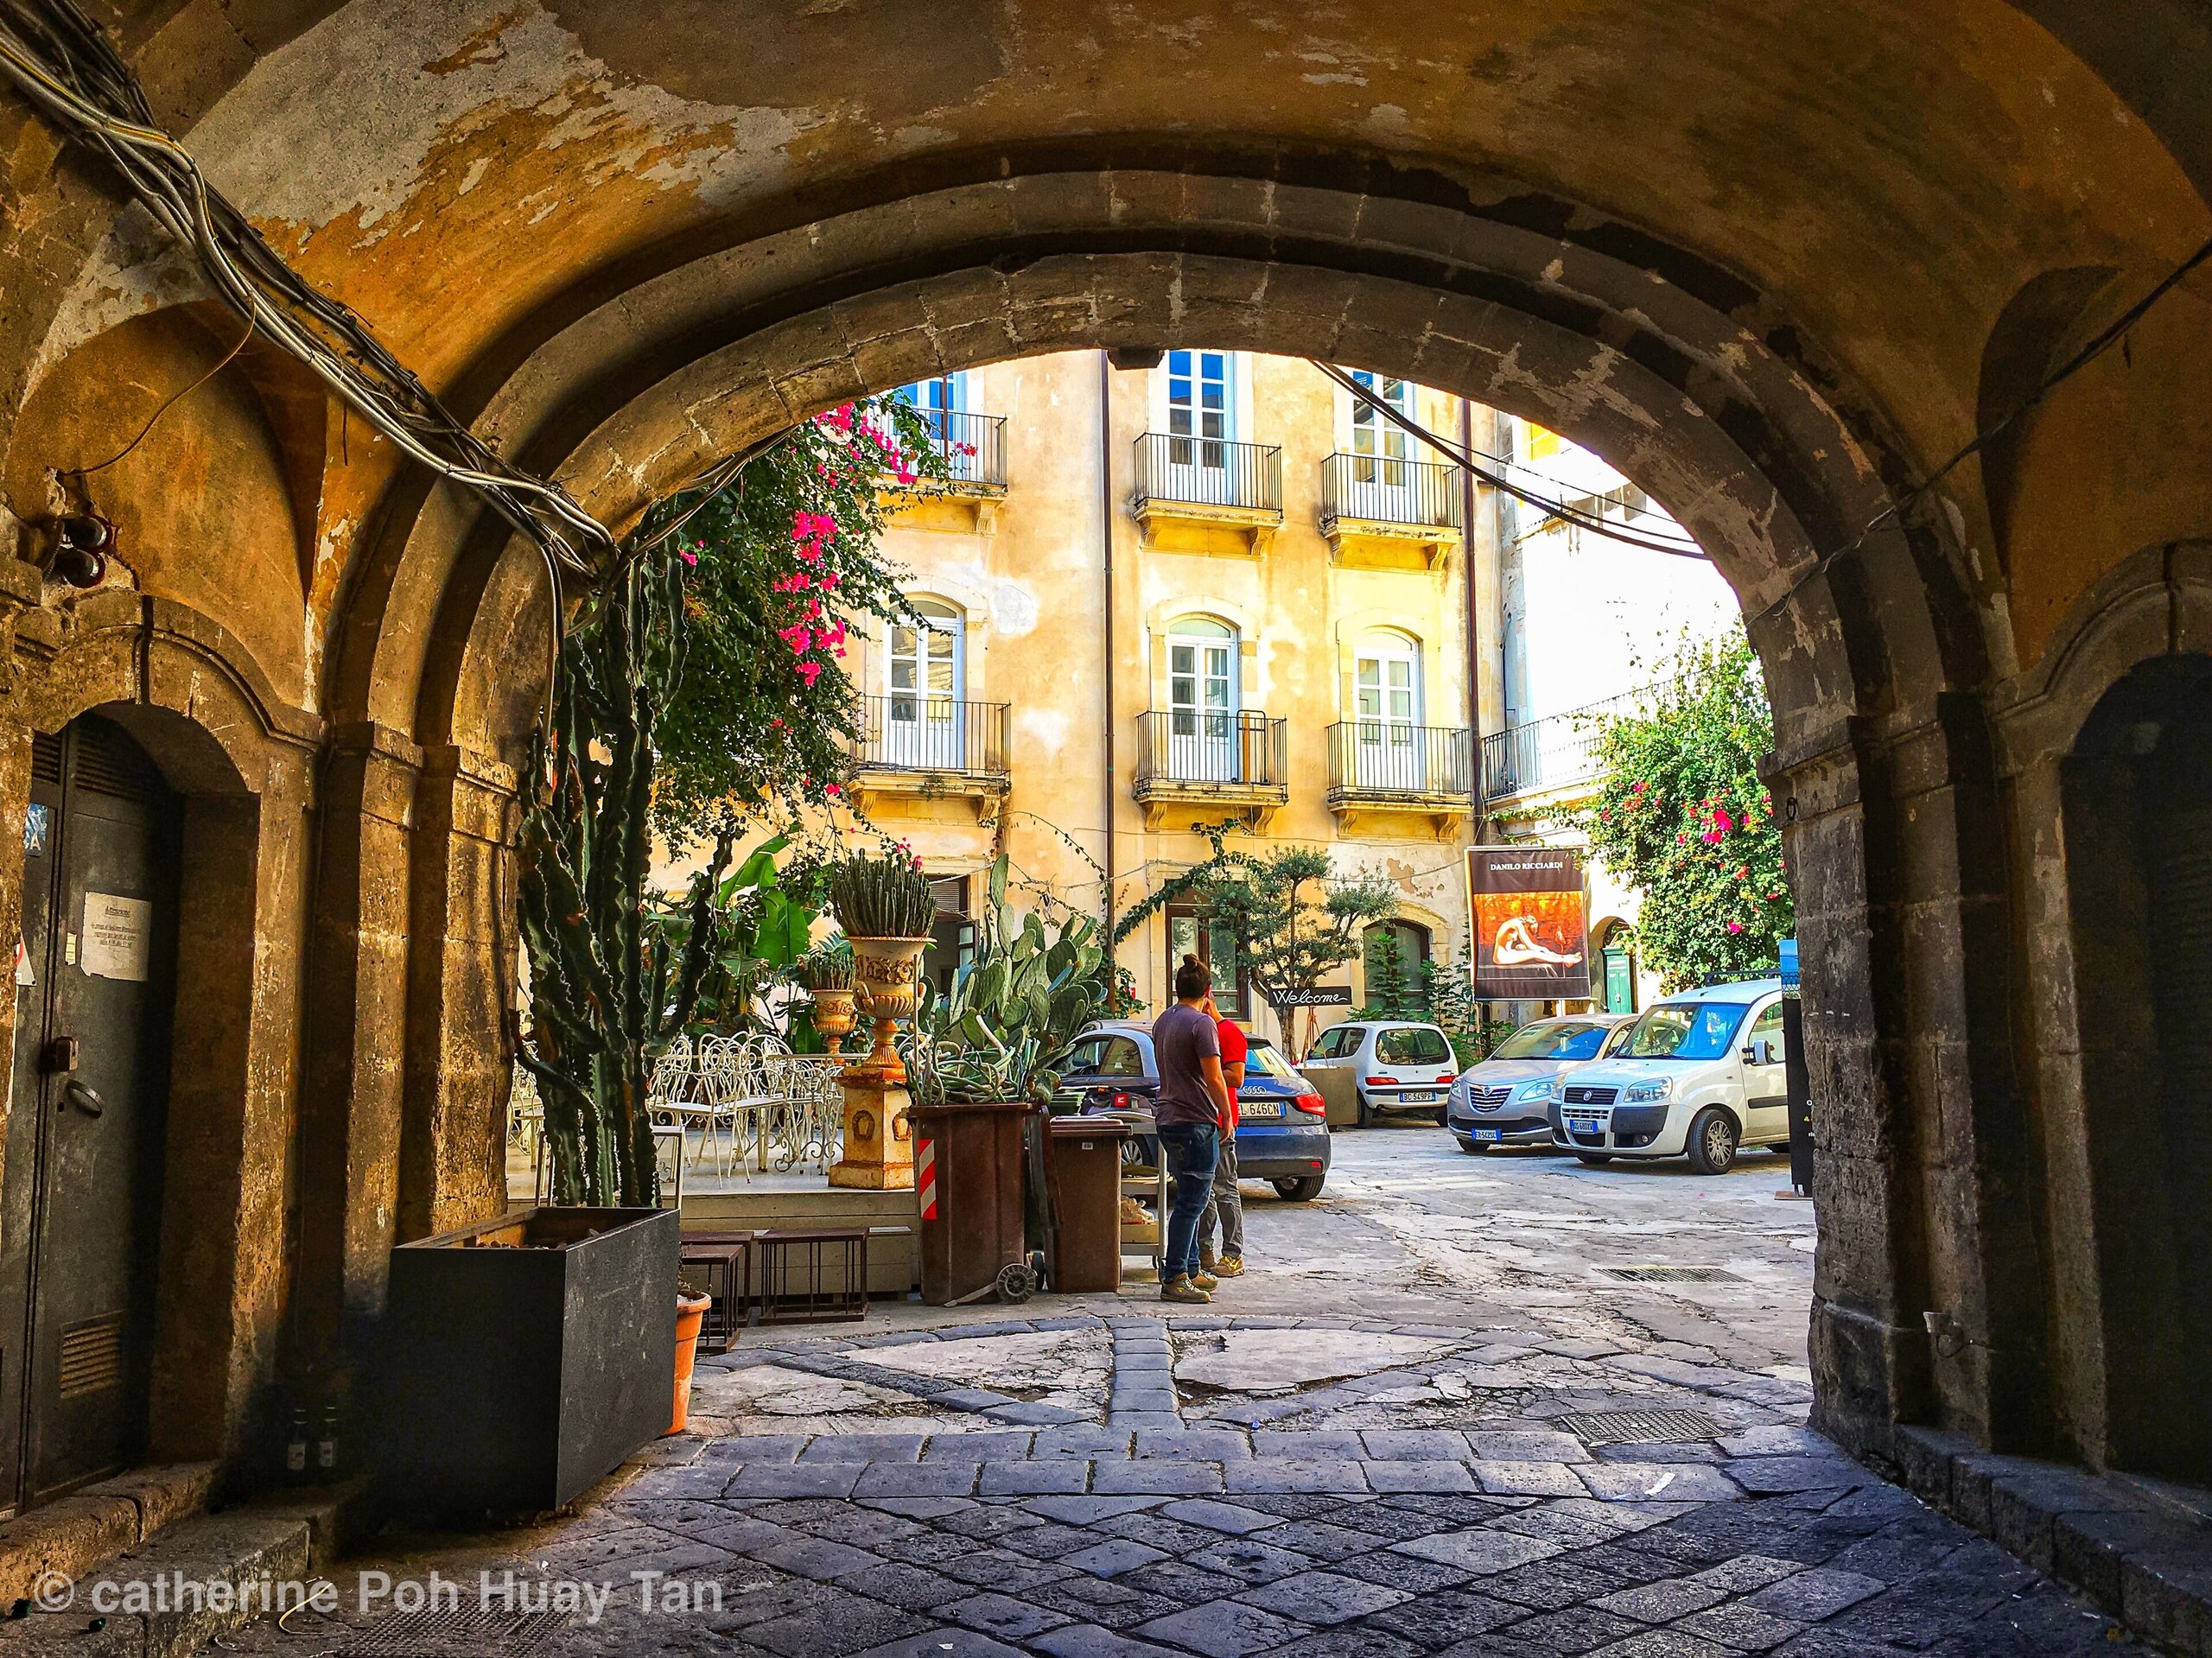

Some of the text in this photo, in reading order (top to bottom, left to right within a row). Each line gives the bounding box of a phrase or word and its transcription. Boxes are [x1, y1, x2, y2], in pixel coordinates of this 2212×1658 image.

[1490, 861, 1563, 871] DANILO RICCIARDI
[1272, 988, 1349, 1004] Welcome
[1403, 1092, 1412, 1101] BC
[1249, 1103, 1280, 1115] 646CN
